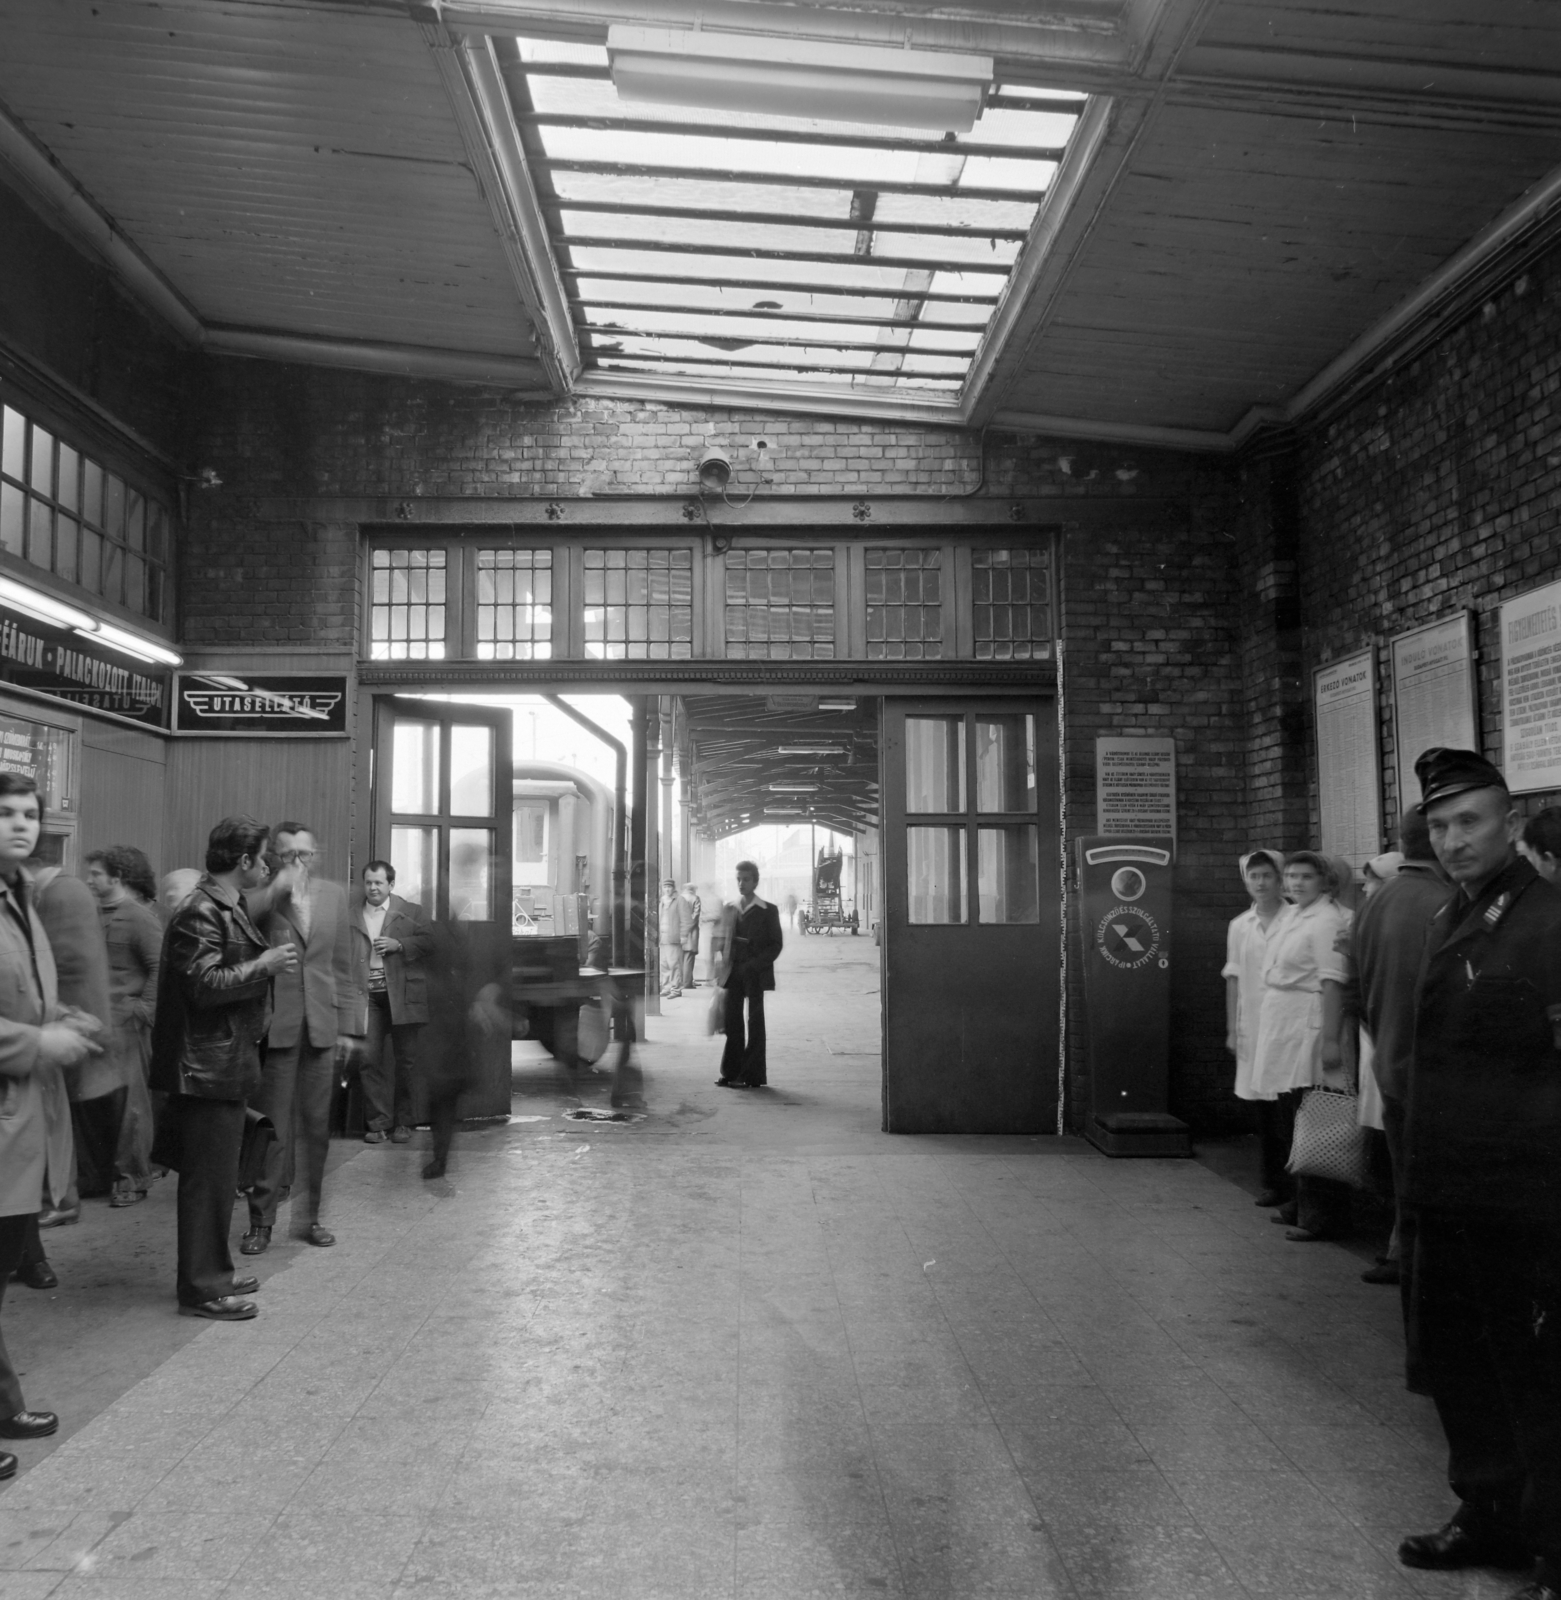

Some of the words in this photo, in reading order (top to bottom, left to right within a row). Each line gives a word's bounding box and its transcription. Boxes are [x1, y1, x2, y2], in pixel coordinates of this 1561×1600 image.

[1508, 605, 1557, 645] FIGYELMEZTETÉS
[1428, 636, 1463, 657] VONATOK
[0, 619, 44, 669] ÉÁRUK
[56, 646, 129, 696] PALACKOZOTT
[132, 673, 163, 708] ITALOK
[1341, 670, 1367, 687] VONATOK
[214, 695, 311, 712] UTASELLÁTÓ
[1128, 906, 1161, 942] SZOLGÁLTATÓ
[1099, 945, 1126, 969] IPARCIKK
[1132, 943, 1159, 969] VÁLLALAT
